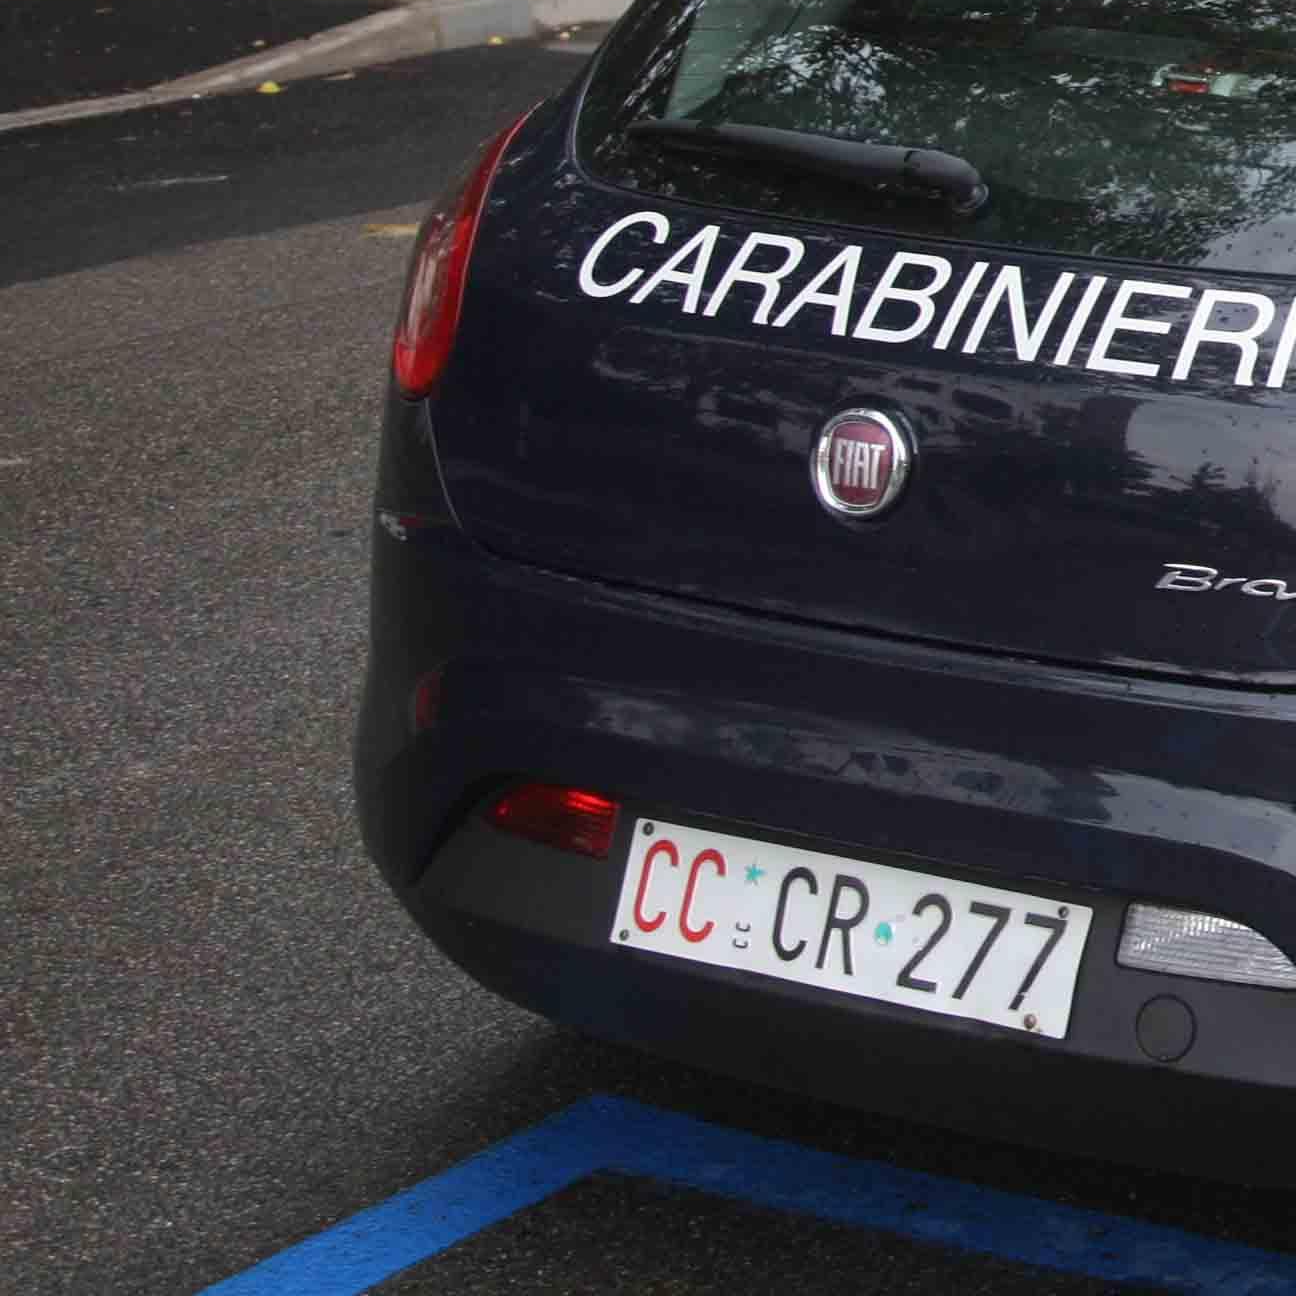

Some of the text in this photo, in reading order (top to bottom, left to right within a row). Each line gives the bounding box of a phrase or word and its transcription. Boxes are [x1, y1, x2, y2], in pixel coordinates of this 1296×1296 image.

[832, 437, 887, 489] FIAT
[633, 839, 1069, 1011] CC CR 277
